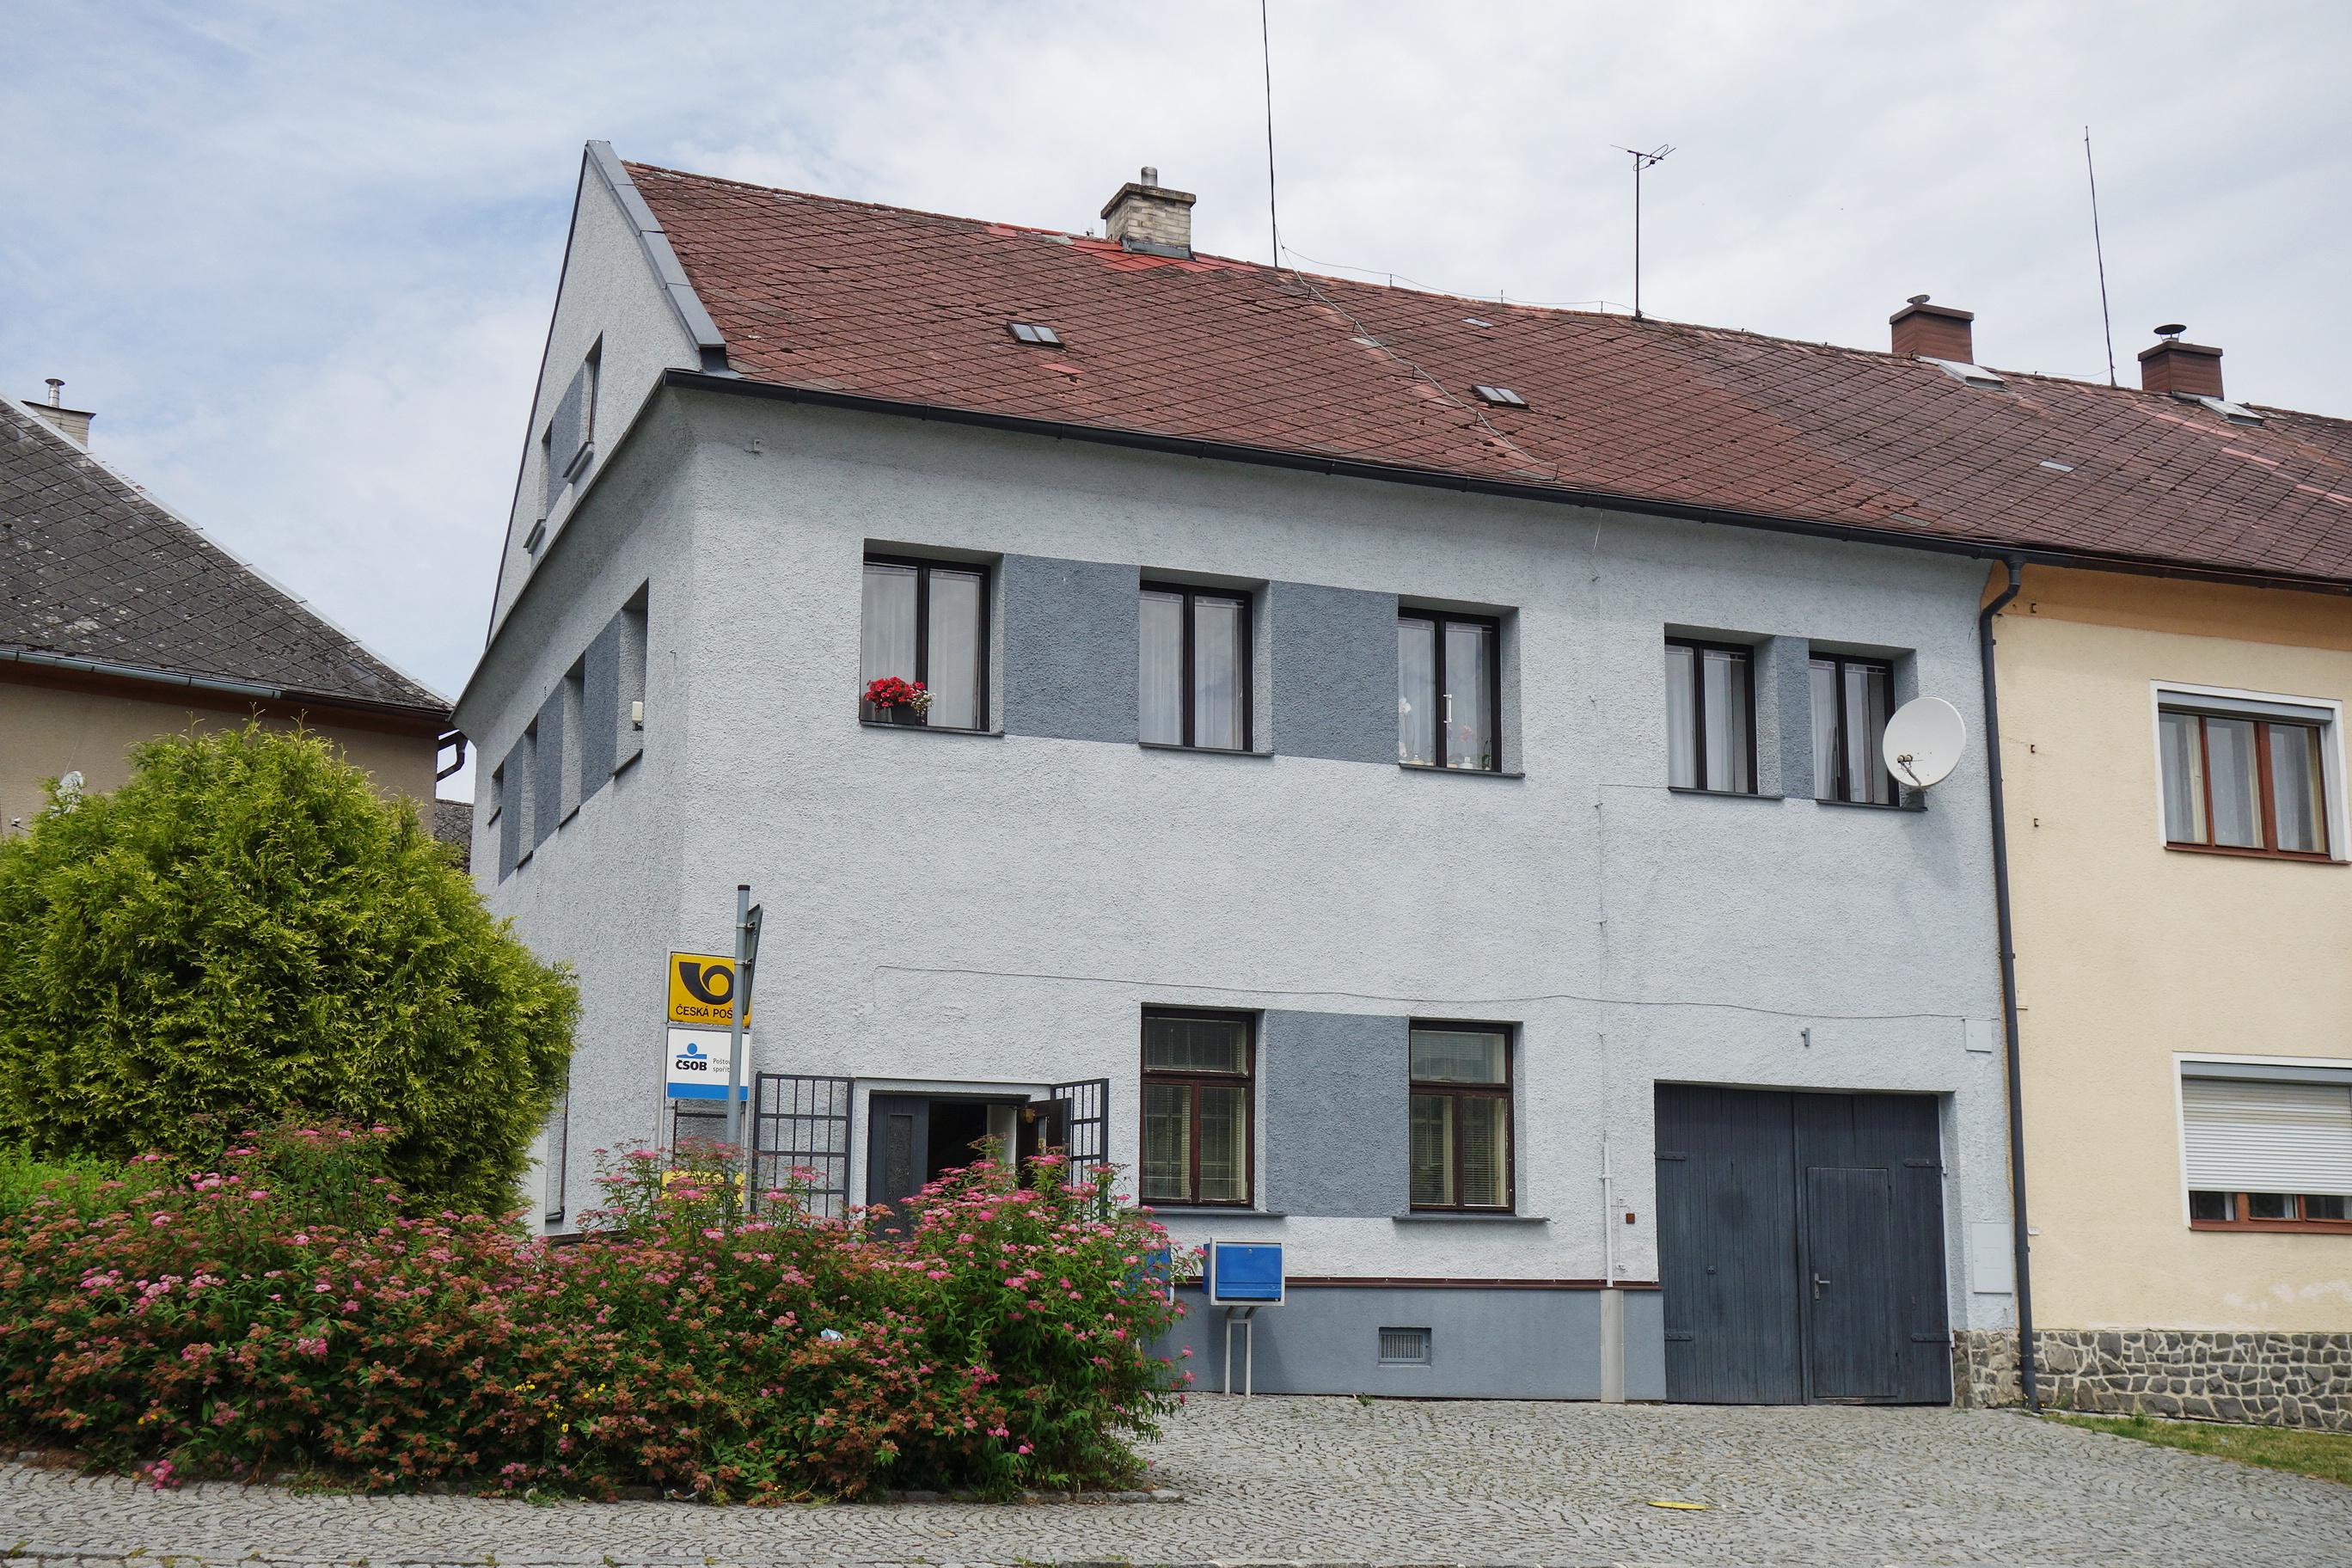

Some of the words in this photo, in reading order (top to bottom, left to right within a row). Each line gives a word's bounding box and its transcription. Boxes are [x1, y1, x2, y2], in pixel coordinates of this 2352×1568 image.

[675, 1004, 709, 1017] ČESKÁ
[713, 1008, 744, 1020] POŠ
[676, 1059, 707, 1071] ČSOB
